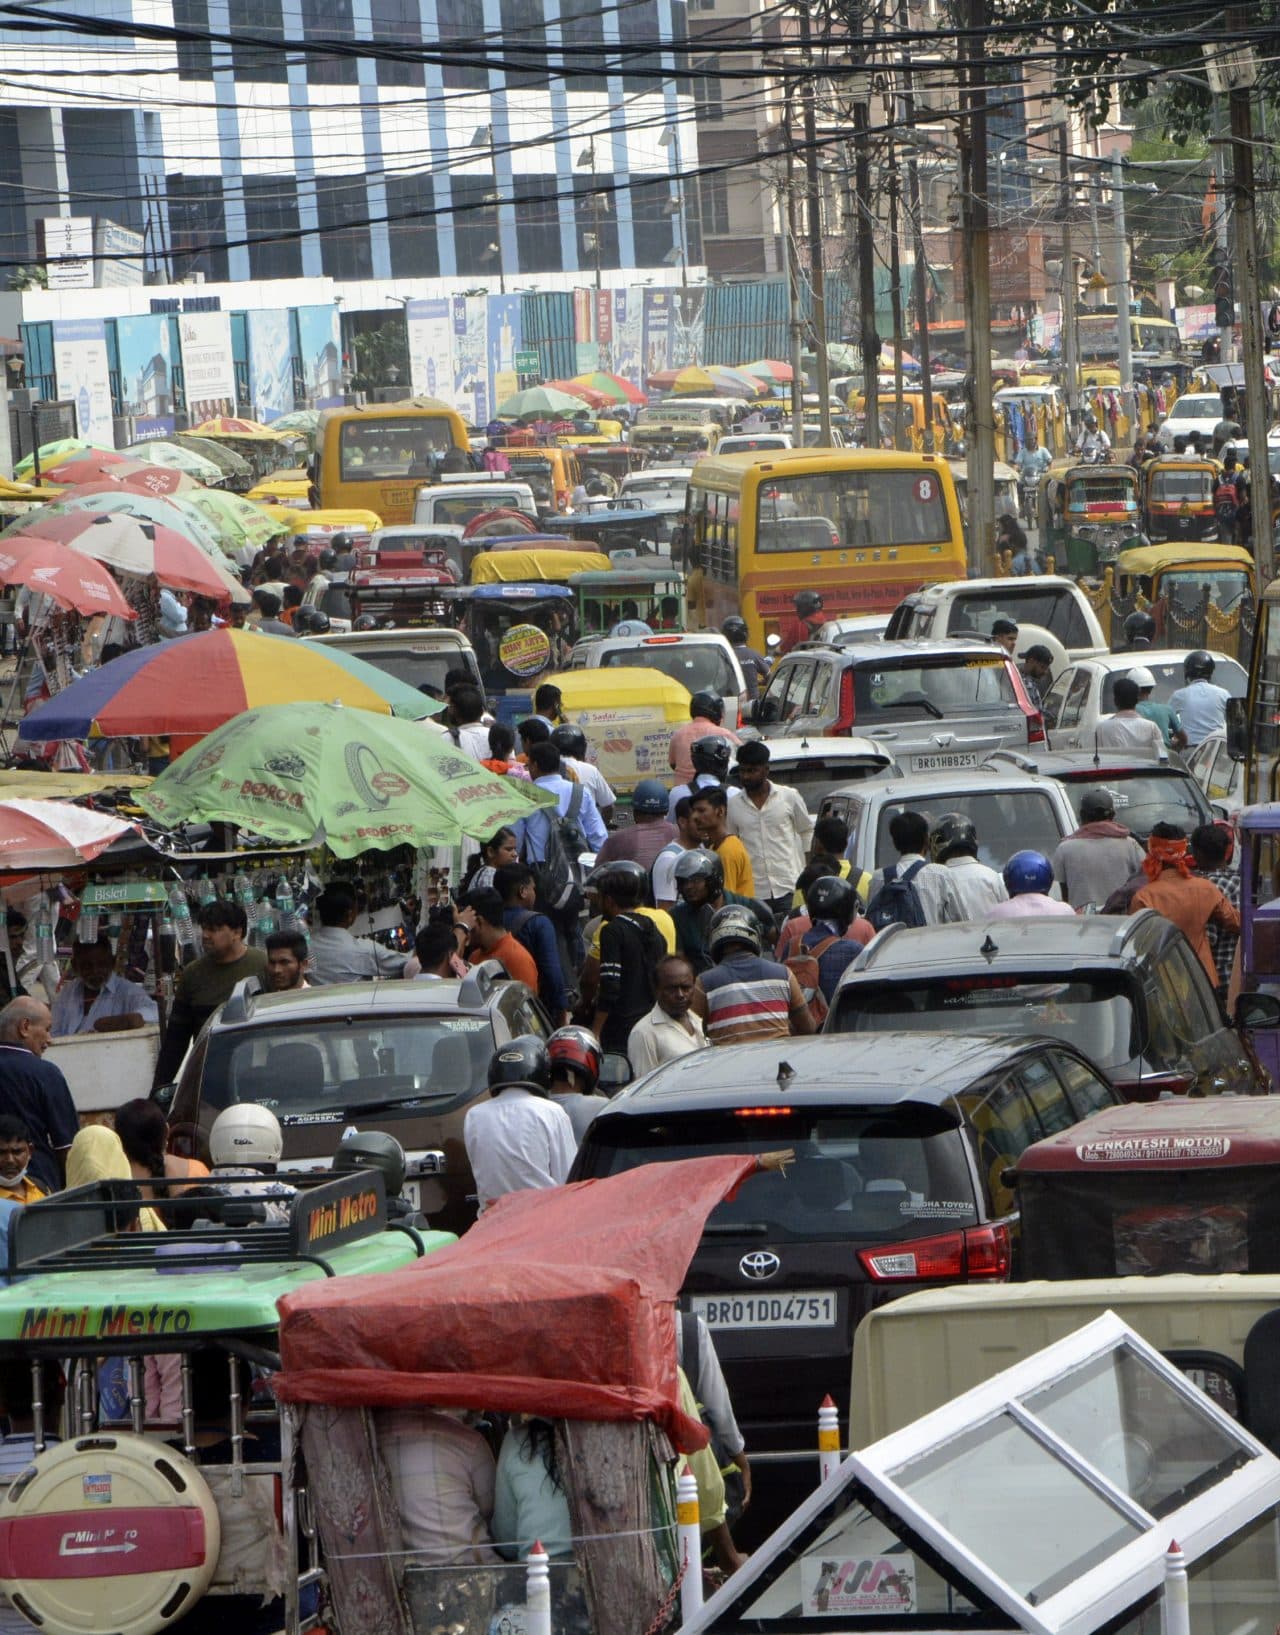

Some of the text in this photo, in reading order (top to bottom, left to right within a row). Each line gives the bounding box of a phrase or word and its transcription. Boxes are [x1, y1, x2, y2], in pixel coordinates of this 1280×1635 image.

[919, 479, 931, 499] 8
[356, 824, 414, 839] BEDROCK
[95, 886, 127, 901] Bisleri
[1086, 1136, 1222, 1150] VENKATESH MOTOR
[942, 1201, 973, 1209] TOYOTA
[310, 1201, 337, 1241] Mini
[340, 1191, 376, 1229] Metro
[707, 1298, 830, 1323] BR01DD4751
[20, 1304, 191, 1339] Mini Metro
